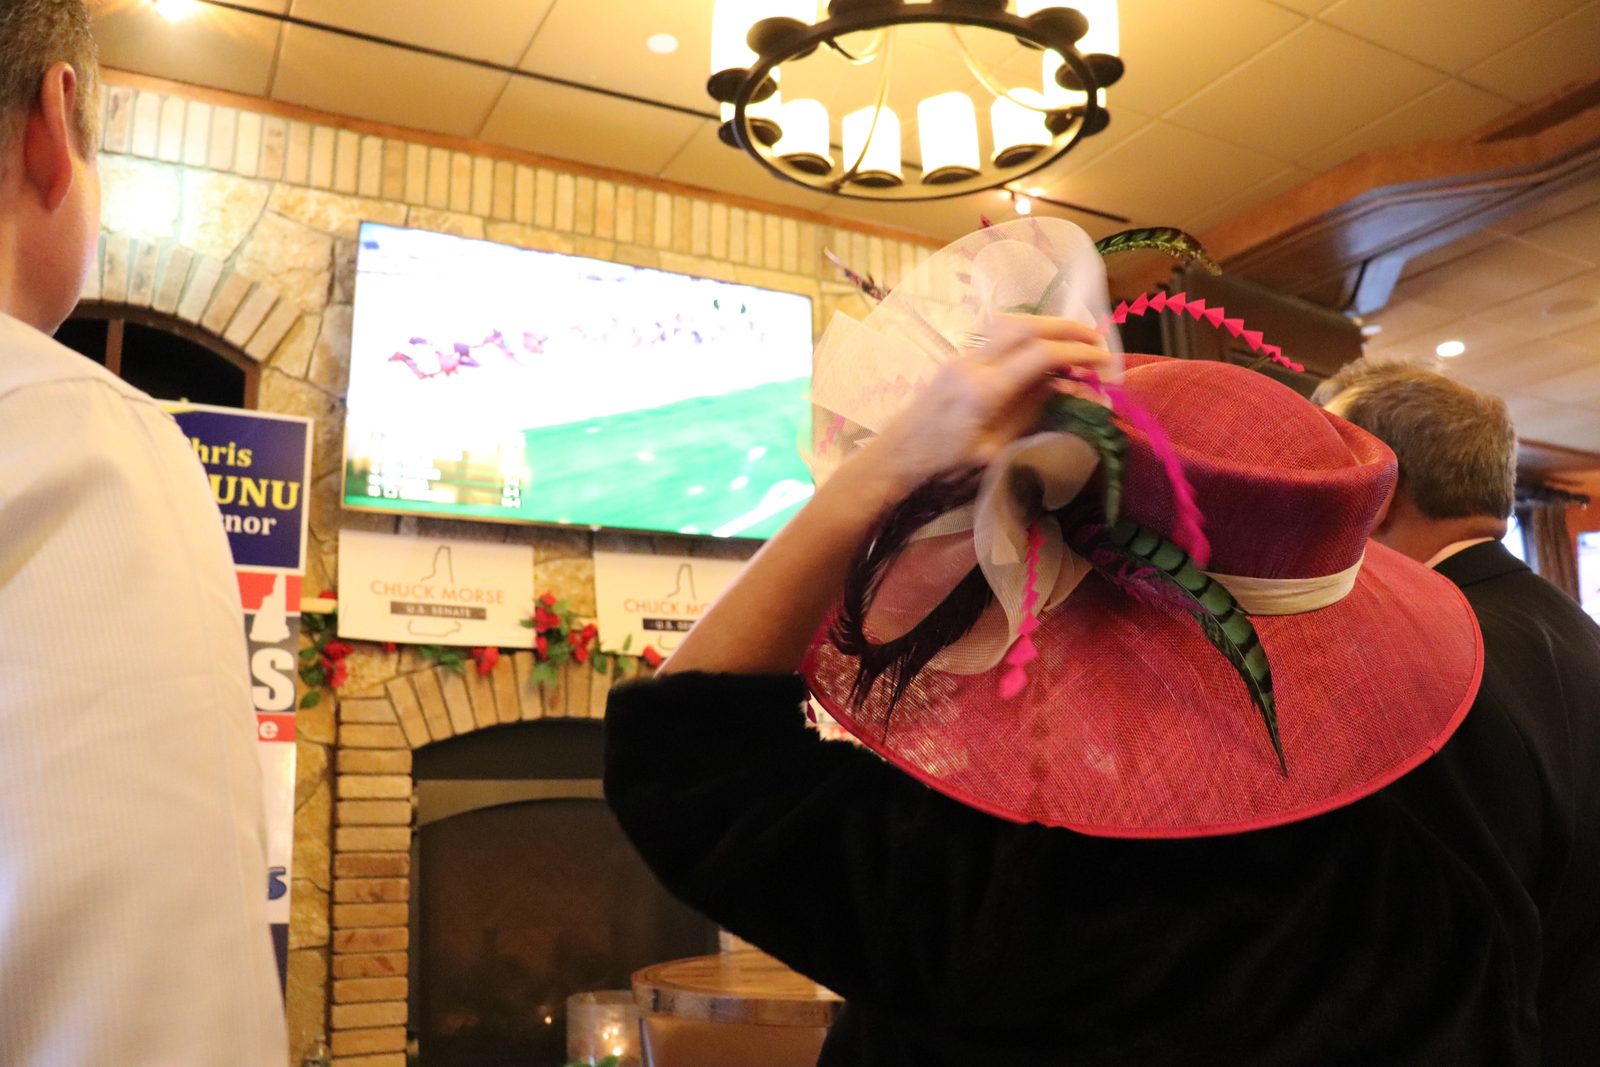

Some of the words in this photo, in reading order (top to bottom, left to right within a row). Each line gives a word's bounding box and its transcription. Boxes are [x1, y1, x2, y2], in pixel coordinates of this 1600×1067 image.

[191, 437, 253, 468] hris
[209, 474, 300, 511] UNU
[221, 514, 277, 536] nor
[370, 580, 434, 600] CHUCK
[442, 587, 505, 604] MORSE
[624, 598, 681, 615] CHUCK
[251, 647, 295, 711] S
[258, 720, 279, 739] e
